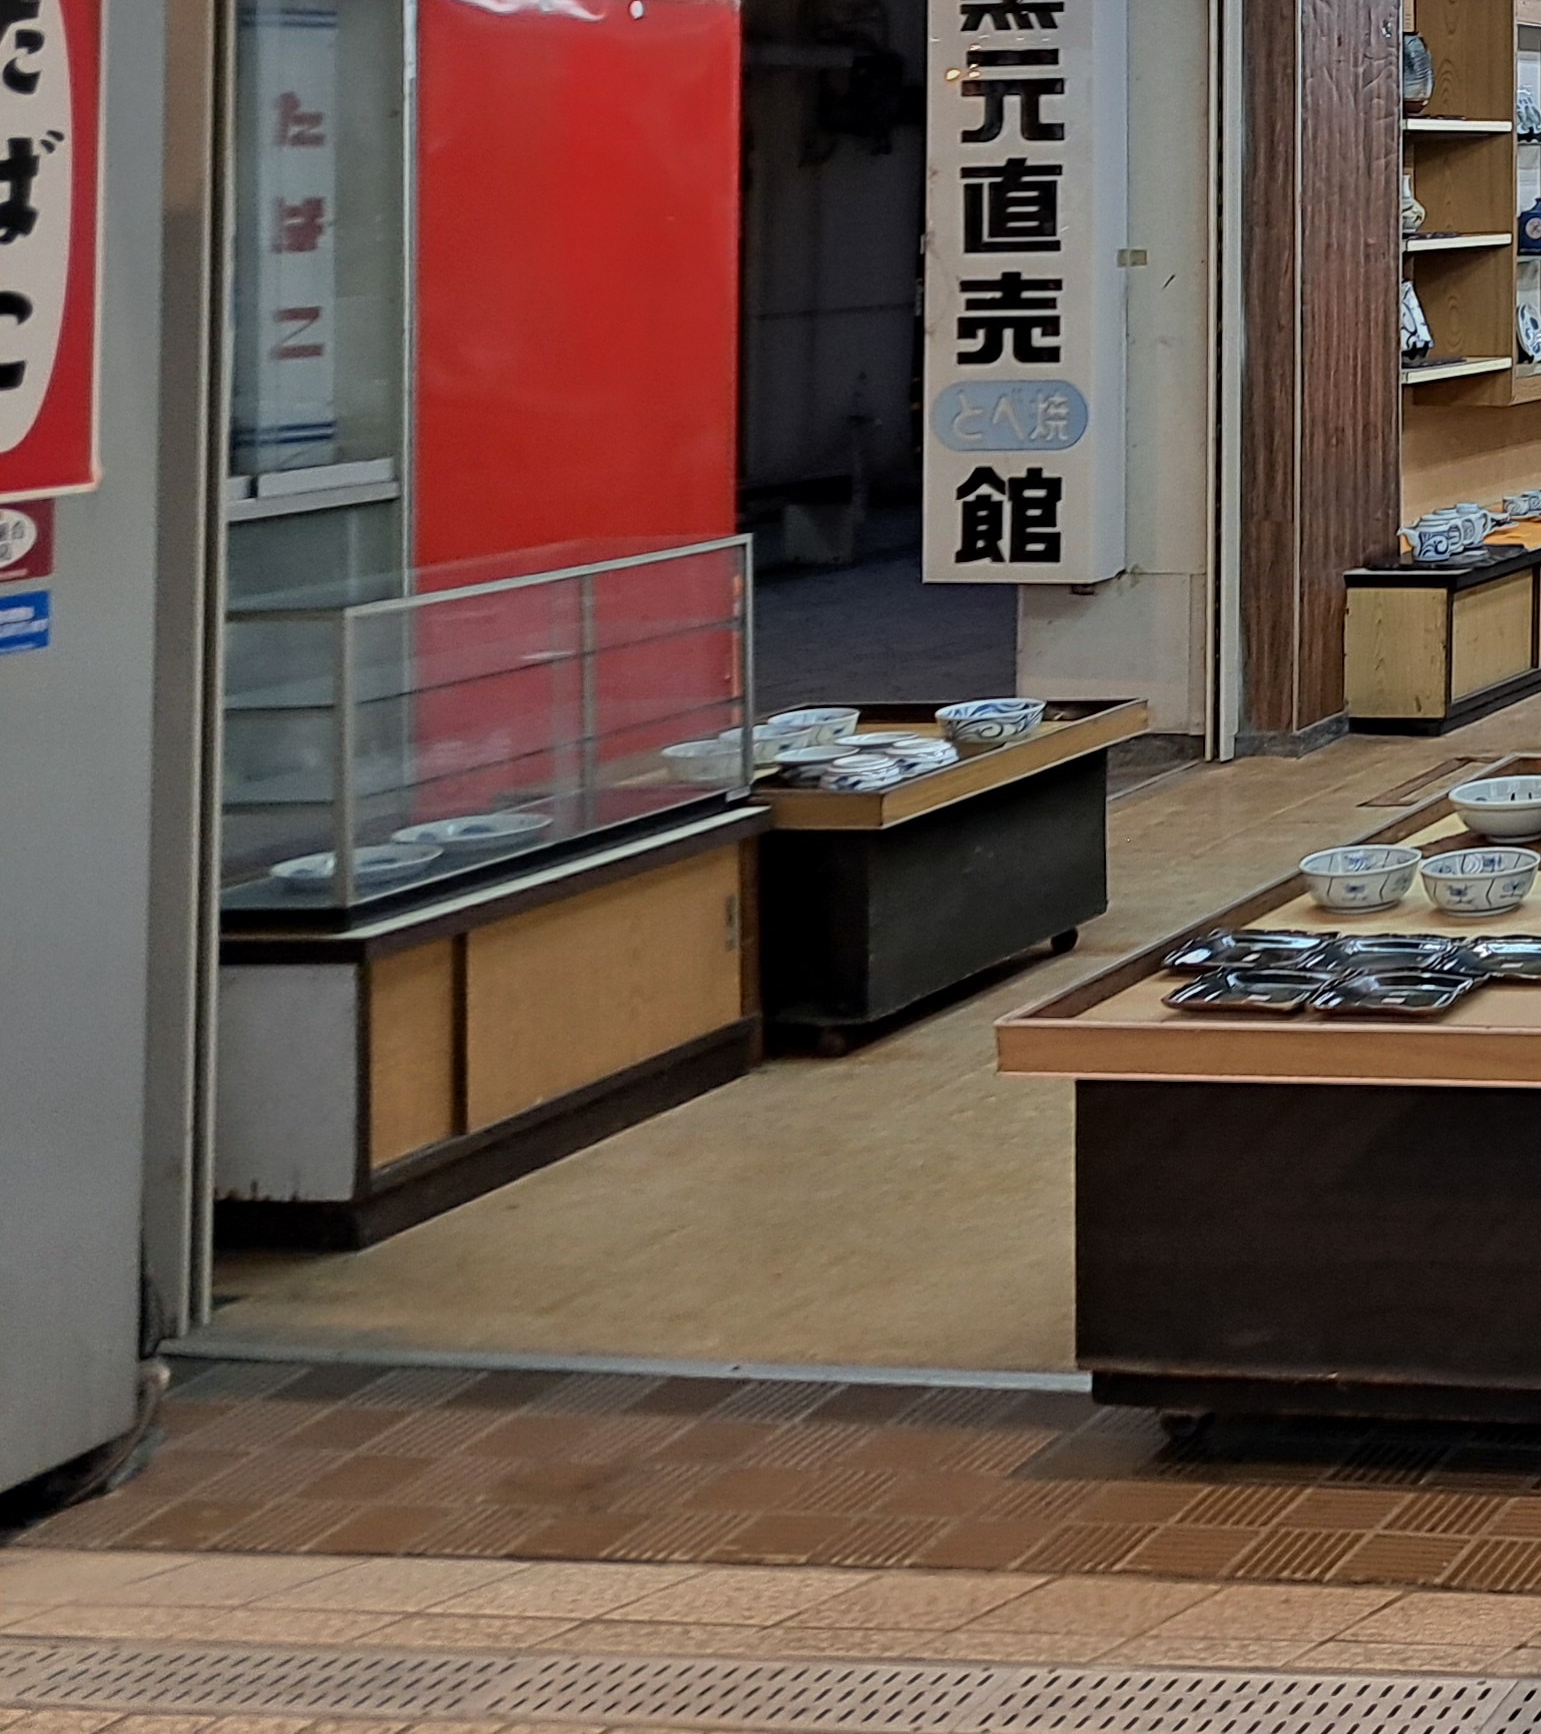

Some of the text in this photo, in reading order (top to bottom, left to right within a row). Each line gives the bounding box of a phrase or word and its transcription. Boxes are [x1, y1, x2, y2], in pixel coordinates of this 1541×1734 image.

[952, 392, 1069, 442] とべ焼
[955, 466, 1062, 566] 館
